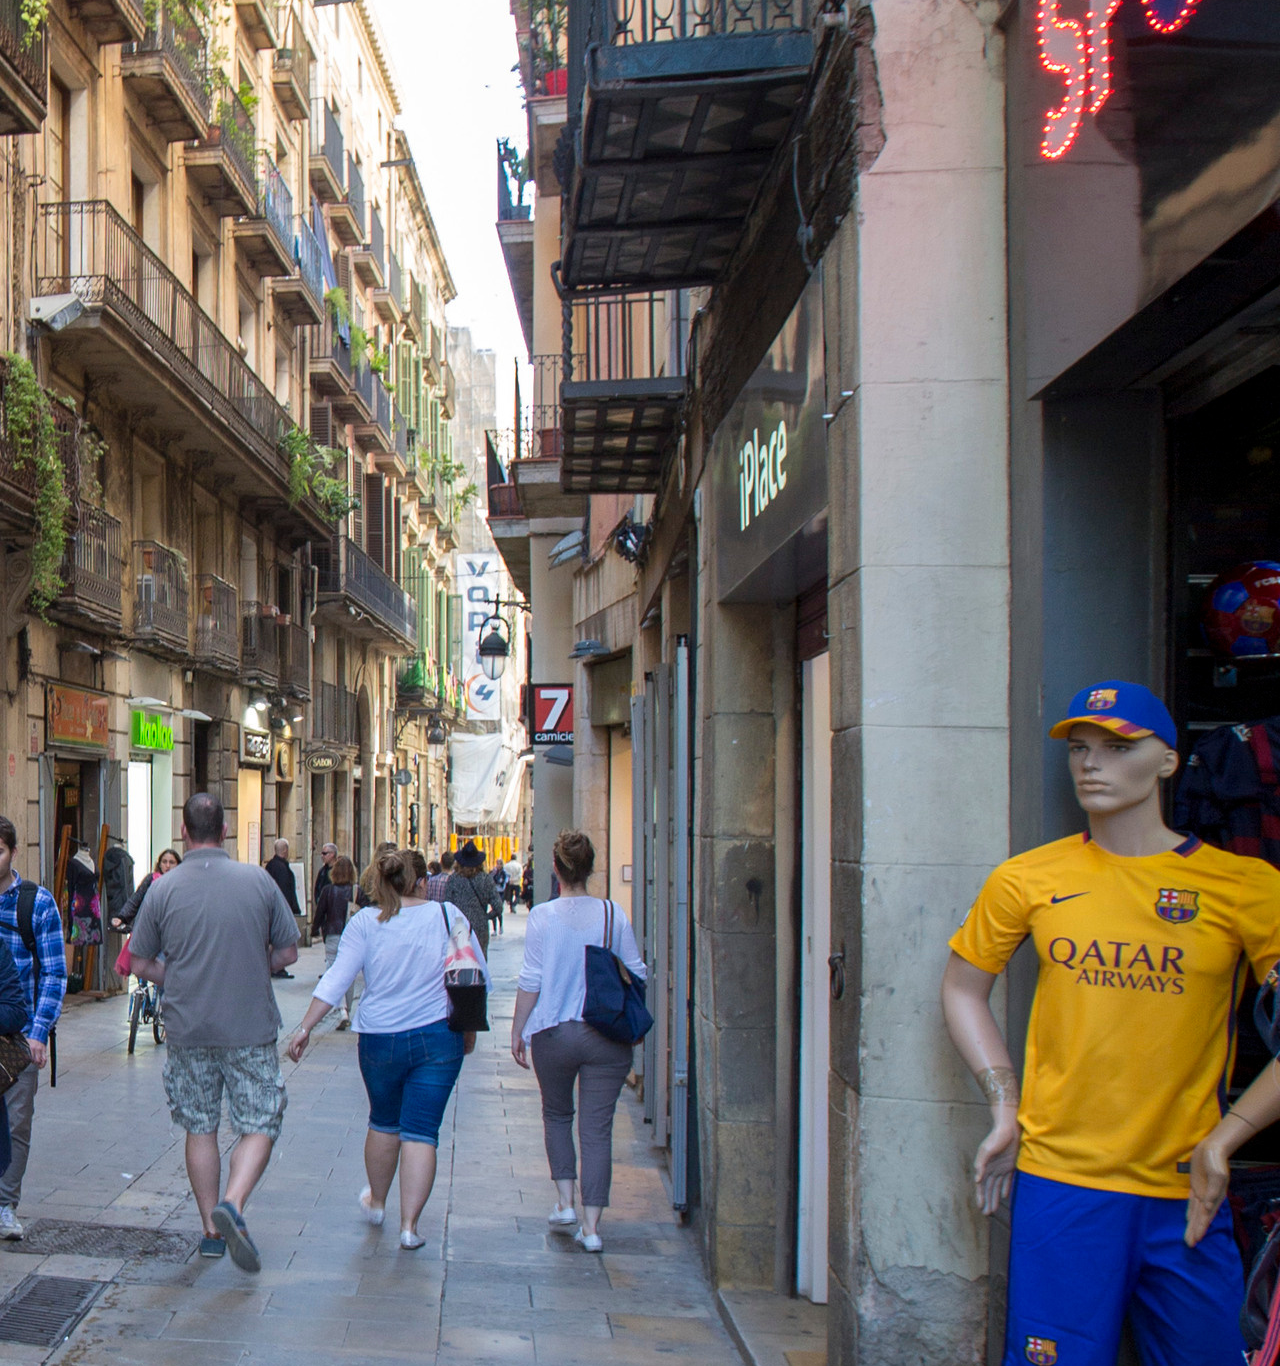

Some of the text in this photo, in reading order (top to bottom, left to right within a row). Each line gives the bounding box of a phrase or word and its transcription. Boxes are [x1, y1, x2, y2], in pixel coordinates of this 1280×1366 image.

[739, 420, 788, 531] iPlace
[540, 690, 569, 730] 7
[312, 757, 333, 767] SABON
[1049, 937, 1185, 974] QATAR
[1076, 969, 1185, 995] AIRWAYS
